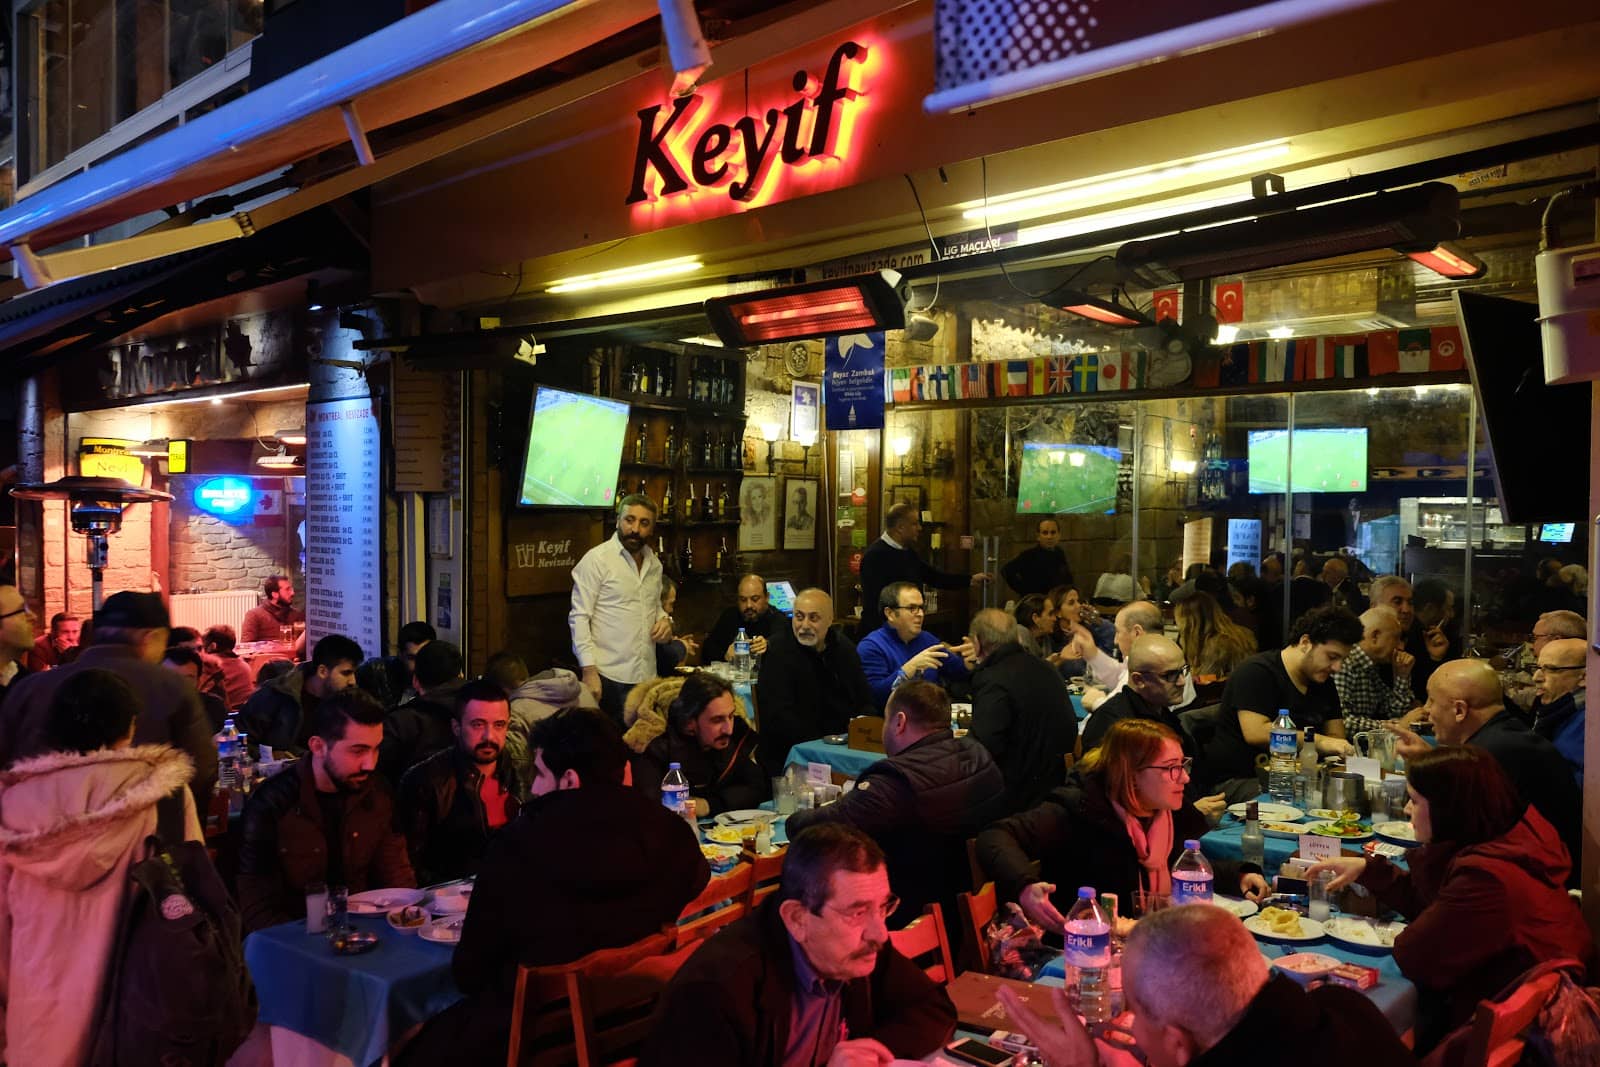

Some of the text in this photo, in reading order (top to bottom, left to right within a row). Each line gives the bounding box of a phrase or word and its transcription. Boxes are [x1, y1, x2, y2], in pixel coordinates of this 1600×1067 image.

[625, 40, 870, 207] Keyif
[538, 539, 571, 557] Keyif
[1182, 882, 1207, 893] Erikli
[1066, 934, 1094, 949] Erikli
